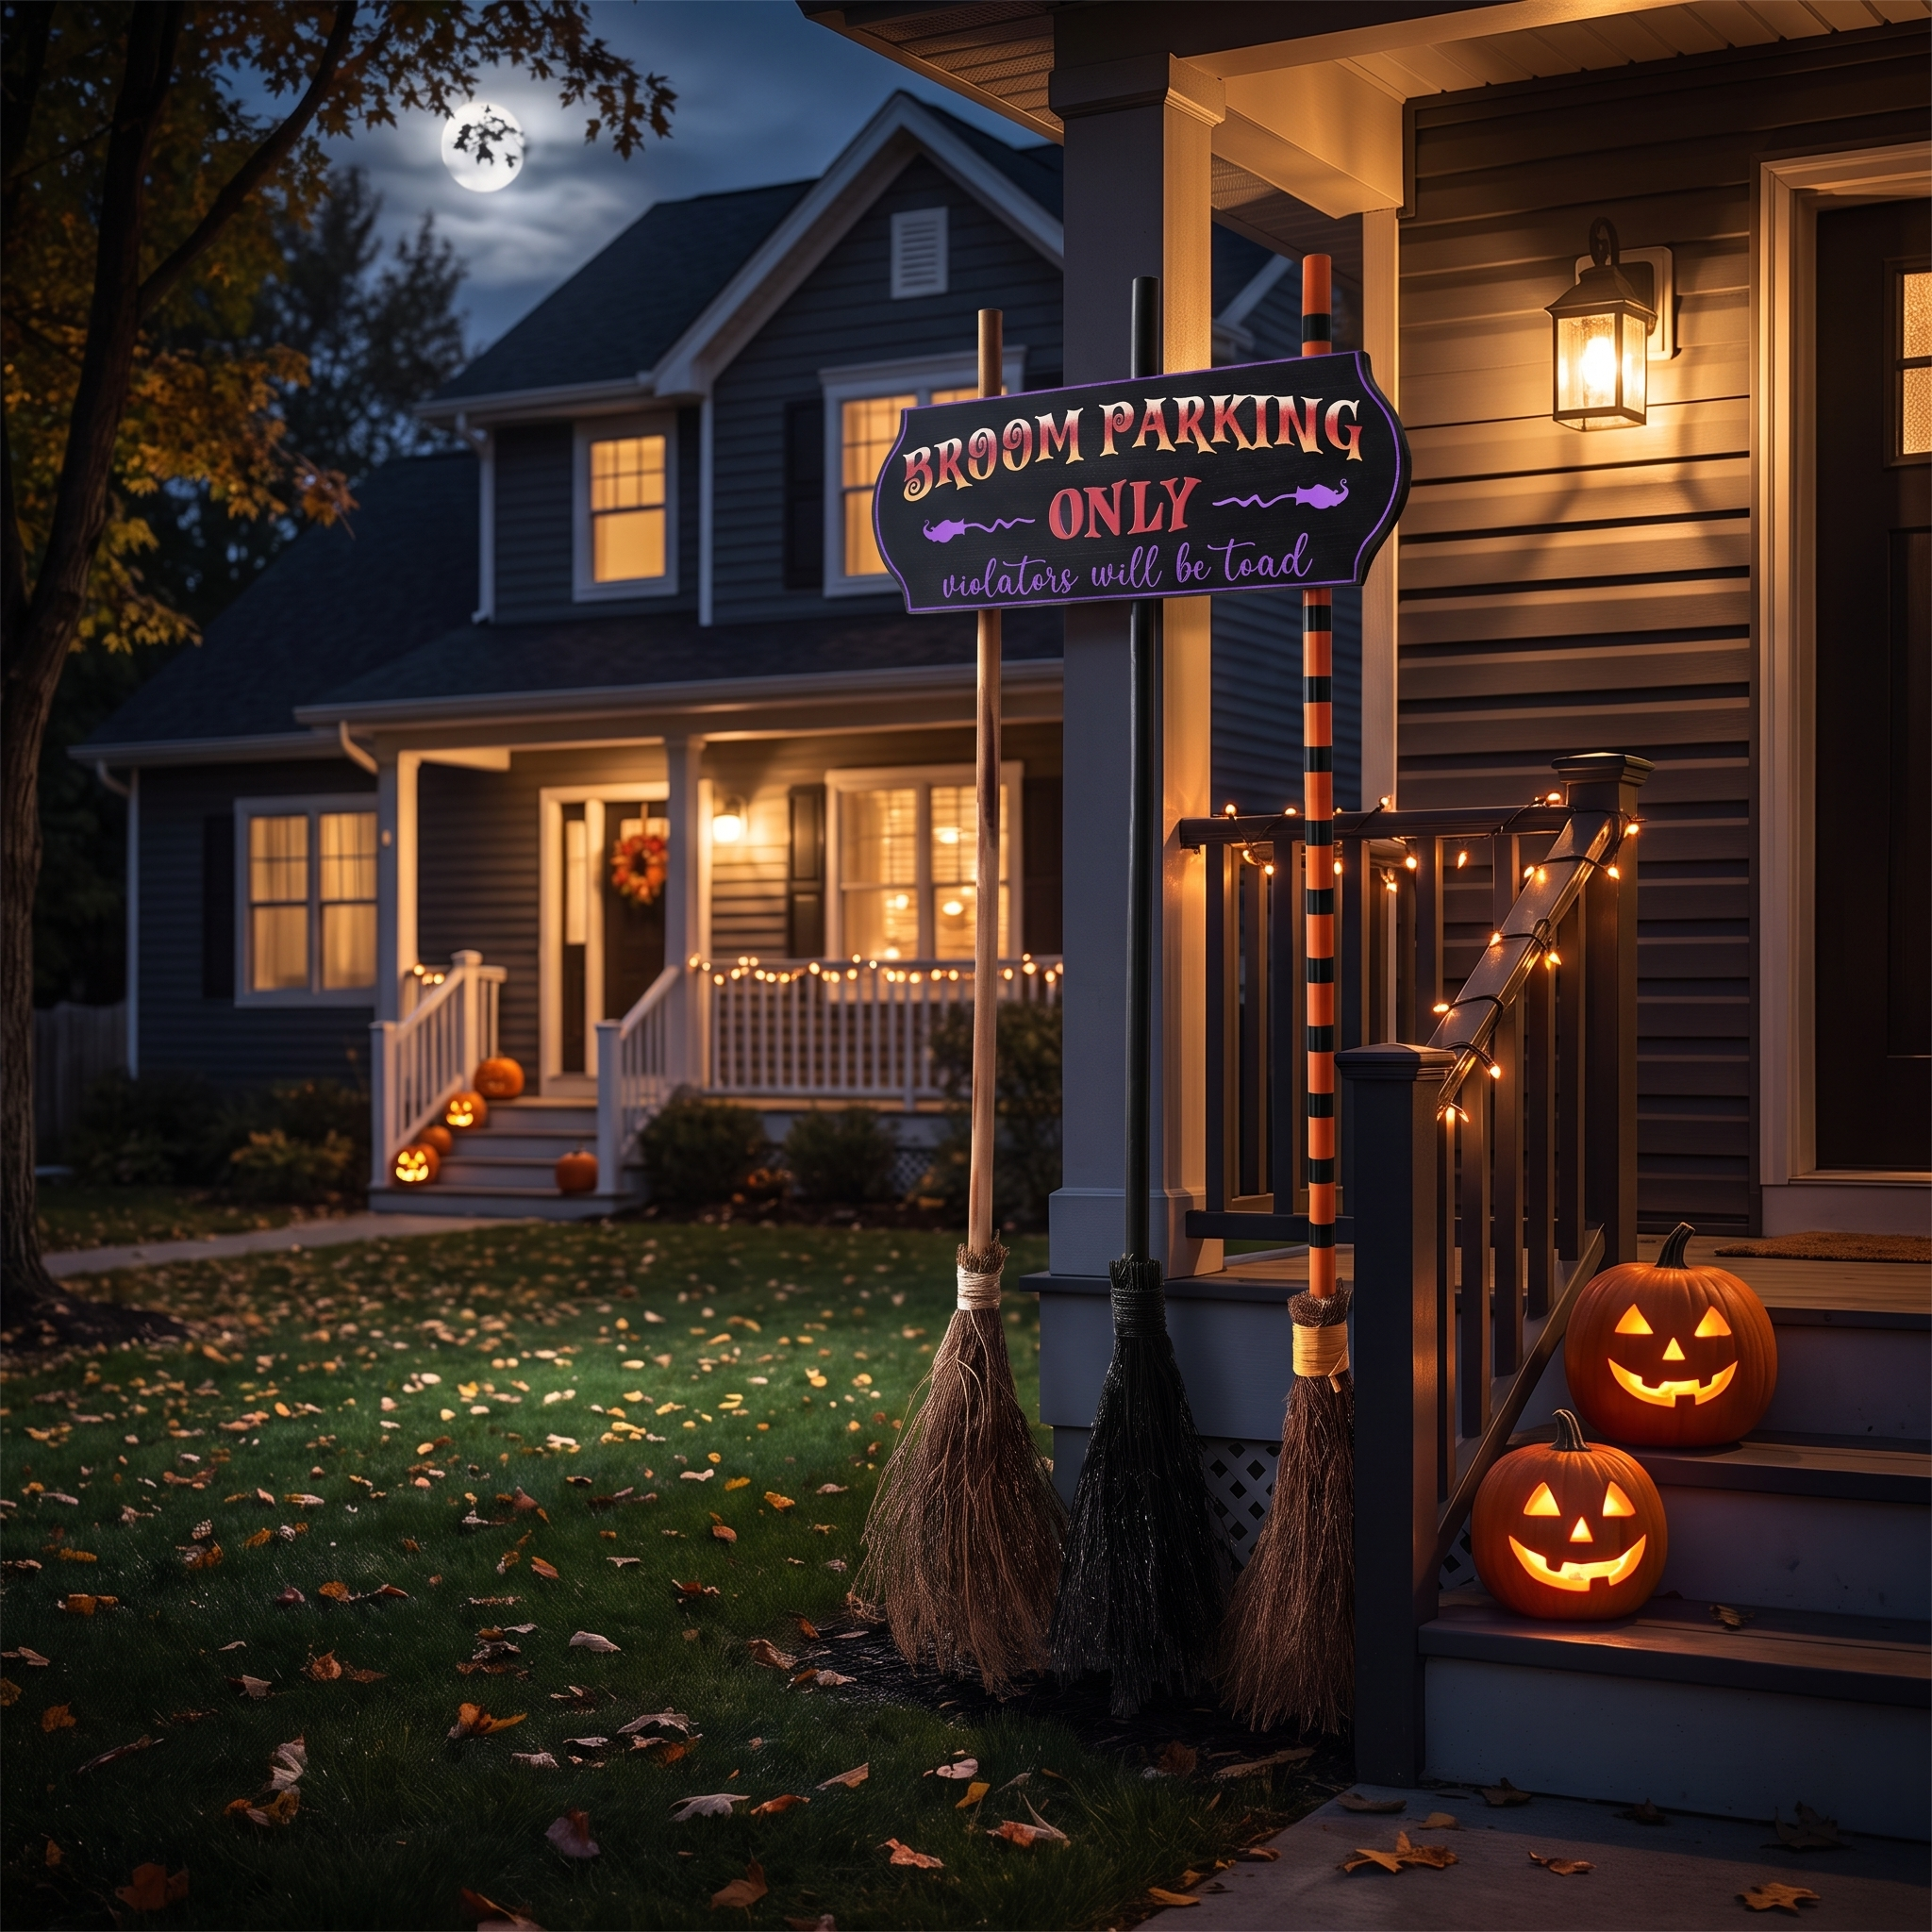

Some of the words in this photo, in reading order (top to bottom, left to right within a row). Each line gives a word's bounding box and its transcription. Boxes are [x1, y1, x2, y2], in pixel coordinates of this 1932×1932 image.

[902, 407, 1084, 502] BROOM
[1098, 393, 1363, 461] PARKING
[1048, 477, 1202, 540] ONLY
[942, 556, 1078, 598] violators
[1091, 545, 1162, 588] will
[1175, 542, 1211, 582] be
[1208, 532, 1312, 581] toad
